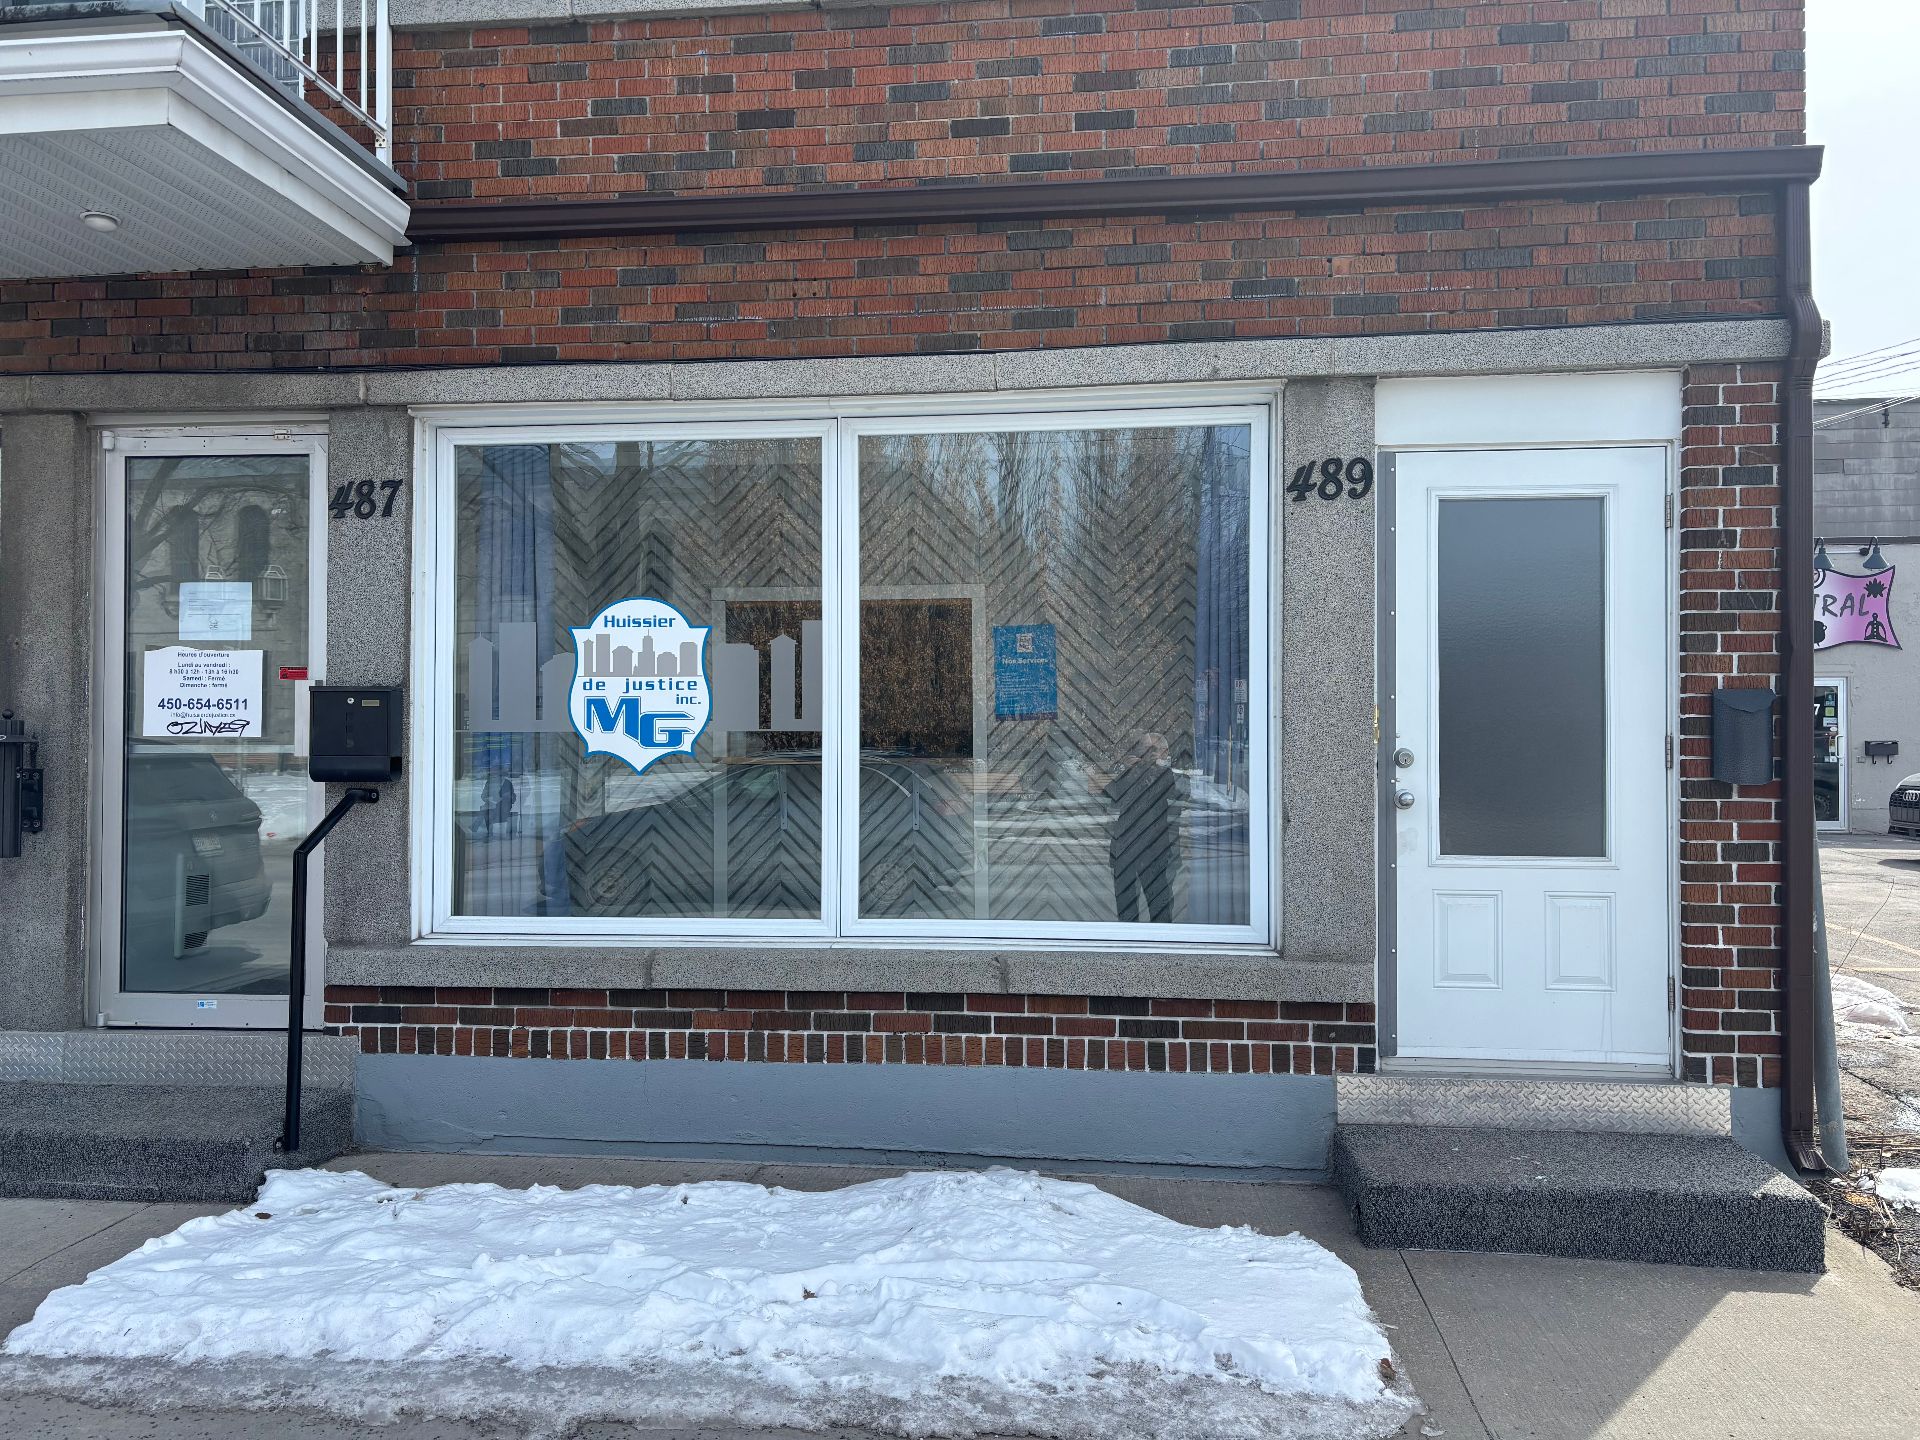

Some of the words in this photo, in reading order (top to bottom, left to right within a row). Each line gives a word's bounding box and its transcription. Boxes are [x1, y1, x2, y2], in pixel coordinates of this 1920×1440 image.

[1285, 457, 1373, 501] 489
[328, 479, 403, 519] 487
[603, 615, 676, 628] Huissier
[582, 678, 606, 691] de
[622, 678, 698, 693] justice
[158, 698, 248, 710] 450-654-6511
[675, 694, 701, 705] inc.
[584, 696, 695, 749] MG
